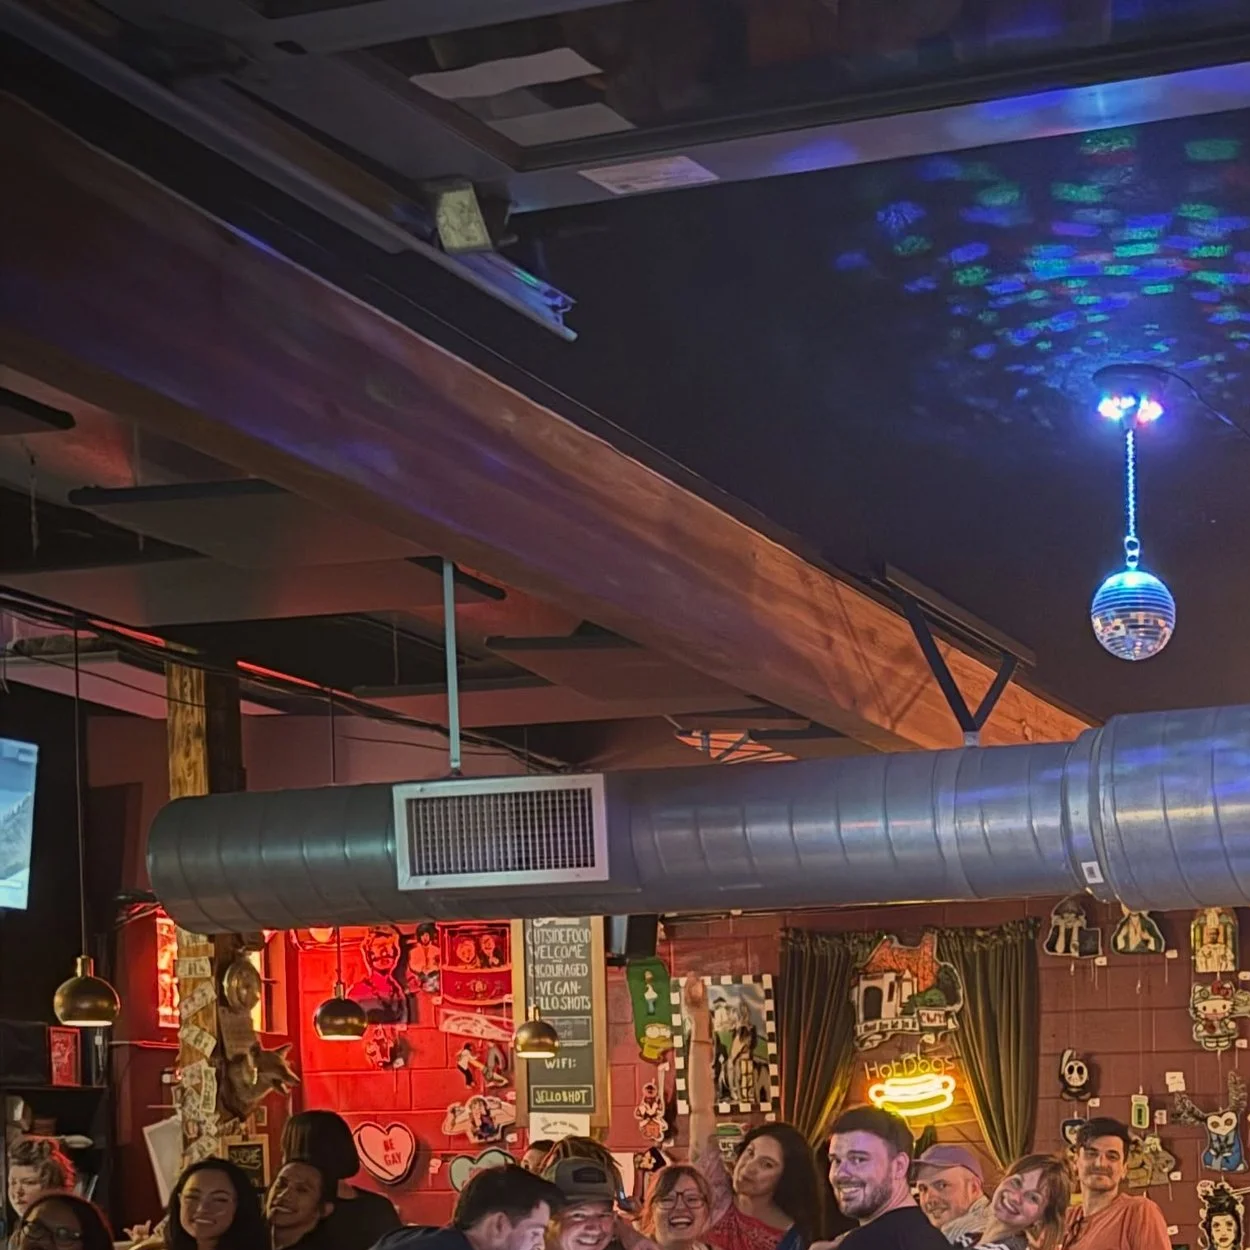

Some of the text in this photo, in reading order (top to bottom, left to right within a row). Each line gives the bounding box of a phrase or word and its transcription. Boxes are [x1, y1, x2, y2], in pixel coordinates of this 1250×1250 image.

[526, 927, 592, 945] OUTSIDE FOOD
[528, 943, 587, 960] WELCOME
[527, 963, 589, 979] ENCOURAGED
[559, 995, 592, 1011] SHOTS
[383, 1137, 395, 1152] BE
[383, 1151, 402, 1167] GAY
